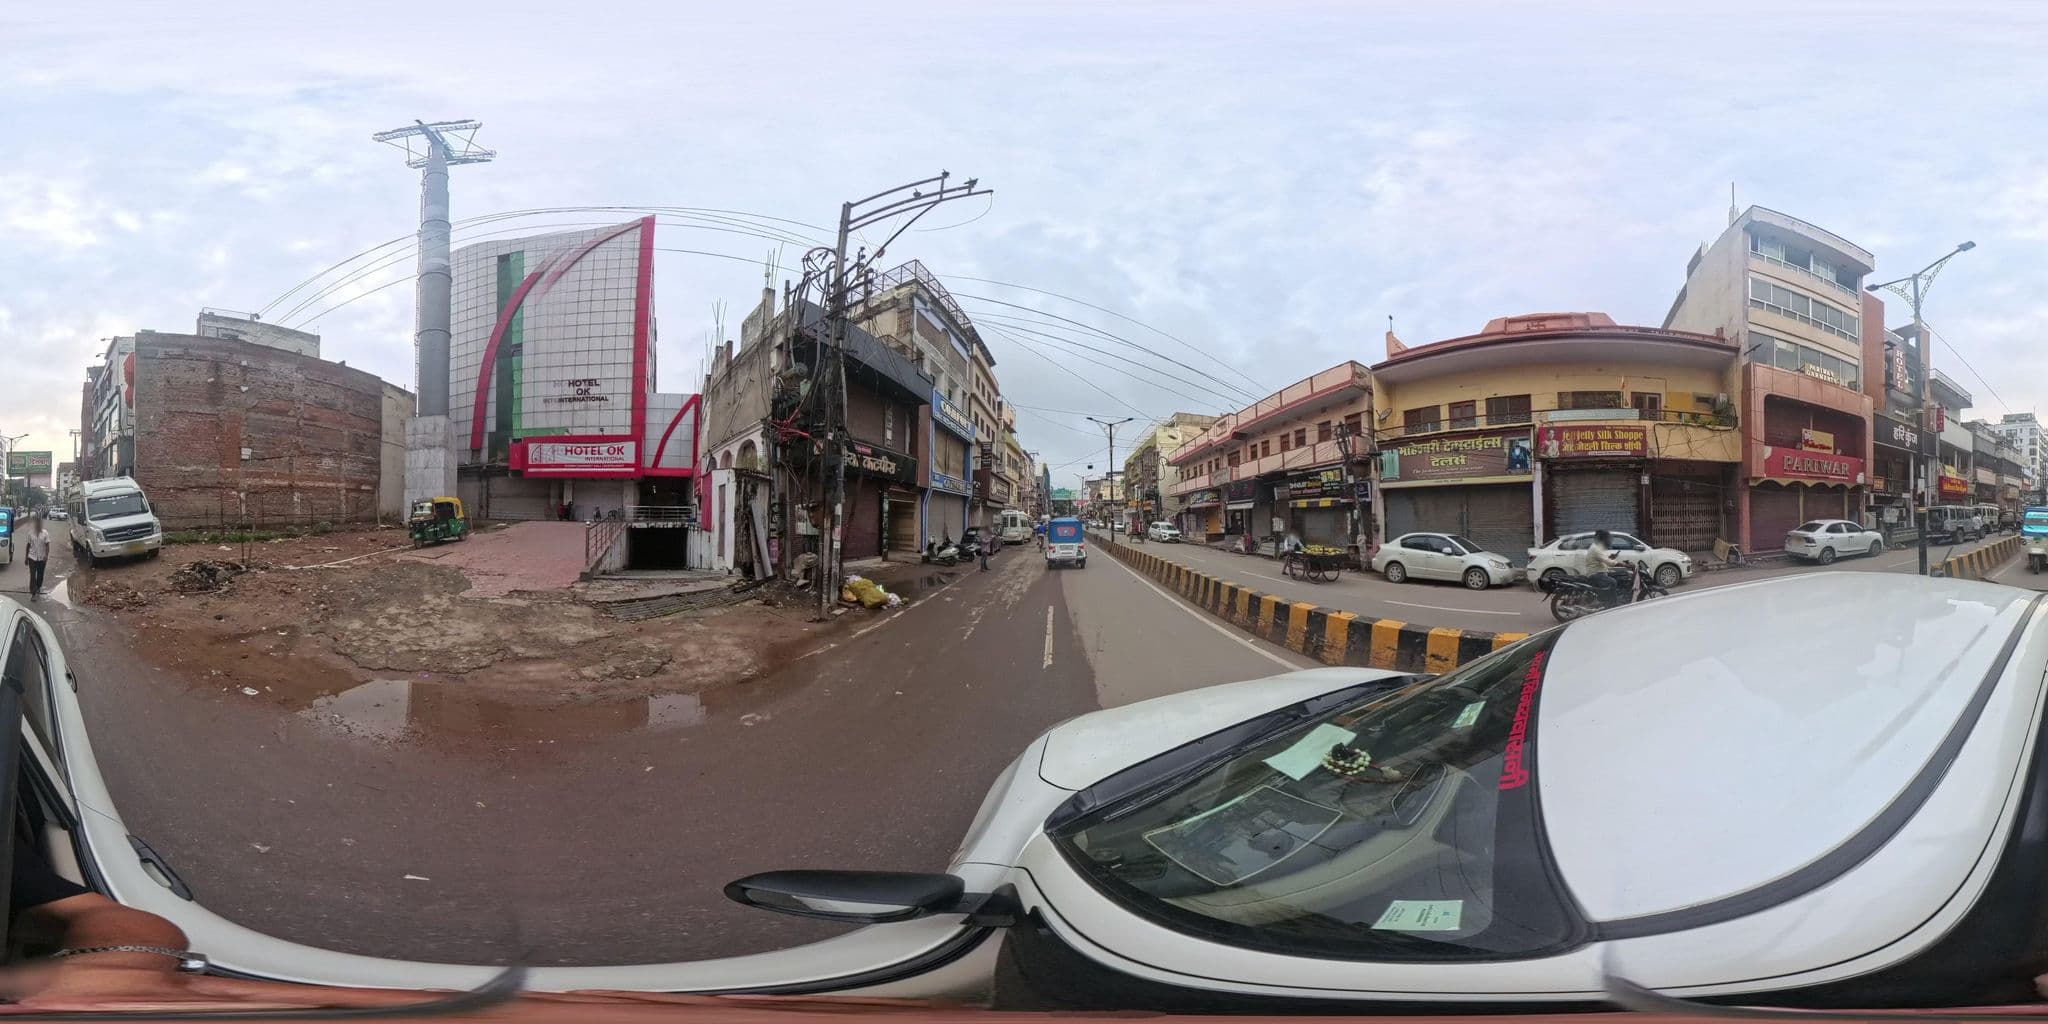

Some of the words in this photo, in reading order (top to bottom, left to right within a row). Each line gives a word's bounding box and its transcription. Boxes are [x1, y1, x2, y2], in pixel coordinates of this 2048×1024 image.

[1895, 349, 1904, 389] HOTEL
[568, 379, 600, 387] HOTEL
[1597, 429, 1612, 440] Silk
[1614, 430, 1644, 441] Shoppe
[565, 446, 603, 455] HOTEL
[607, 446, 624, 455] OK
[1783, 455, 1850, 476] PARIWAR
